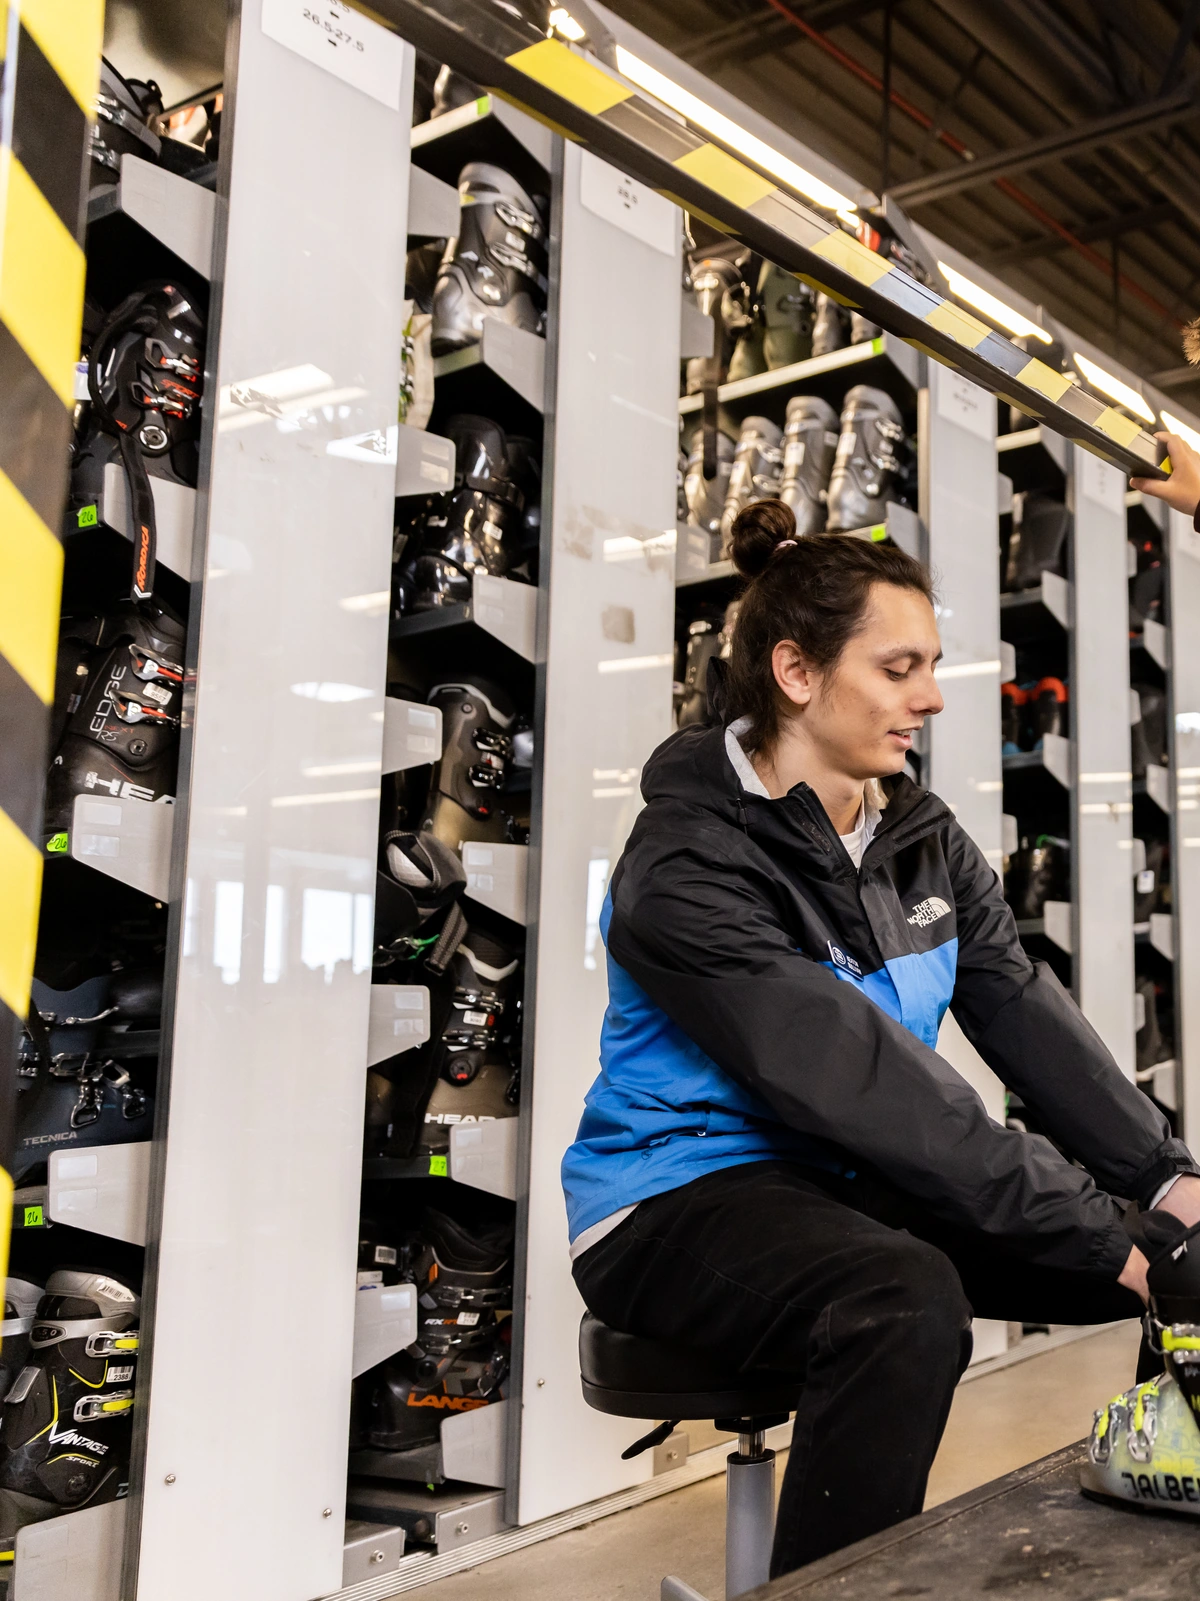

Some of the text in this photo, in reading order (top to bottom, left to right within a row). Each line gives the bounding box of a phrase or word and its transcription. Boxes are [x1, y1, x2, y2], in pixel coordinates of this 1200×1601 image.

[137, 525, 149, 592] NORDICA
[89, 664, 127, 732] EDGE
[912, 900, 931, 914] THE
[907, 907, 936, 925] NORTH
[917, 913, 938, 928] FACE
[23, 1131, 78, 1146] TECNICA
[49, 1420, 109, 1456] VANTAGE
[65, 1456, 100, 1468] SPORT
